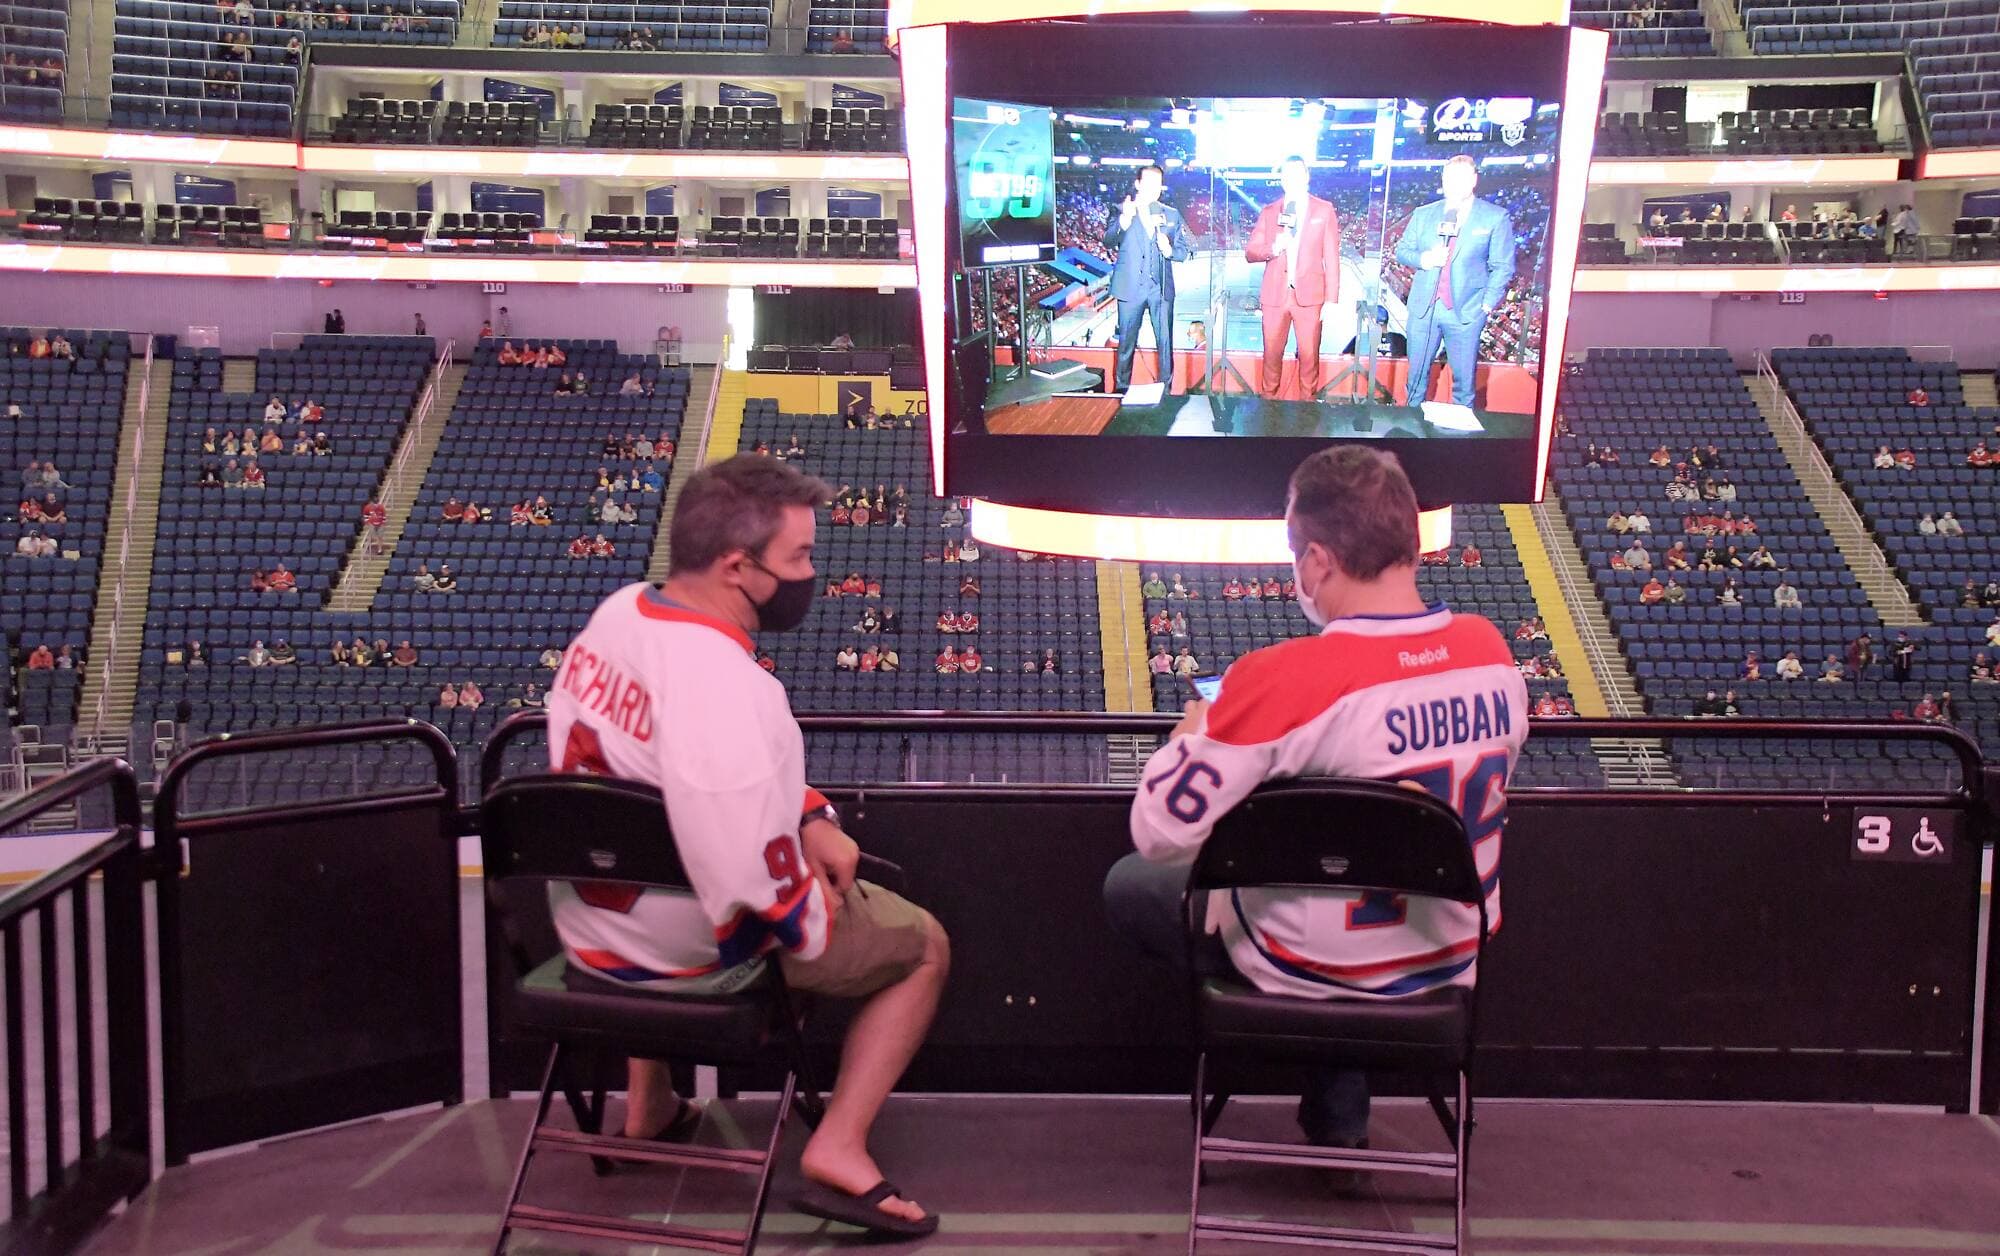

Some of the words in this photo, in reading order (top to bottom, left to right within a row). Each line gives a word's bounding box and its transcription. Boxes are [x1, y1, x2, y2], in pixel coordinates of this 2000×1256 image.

[482, 282, 505, 293] 110
[665, 284, 685, 293] 110
[1782, 292, 1804, 303] 113
[1398, 645, 1450, 668] Reebok
[1385, 689, 1510, 755] SUBBAN
[1146, 738, 1223, 824] 76
[1857, 815, 1891, 852] 3
[764, 834, 802, 904] 9
